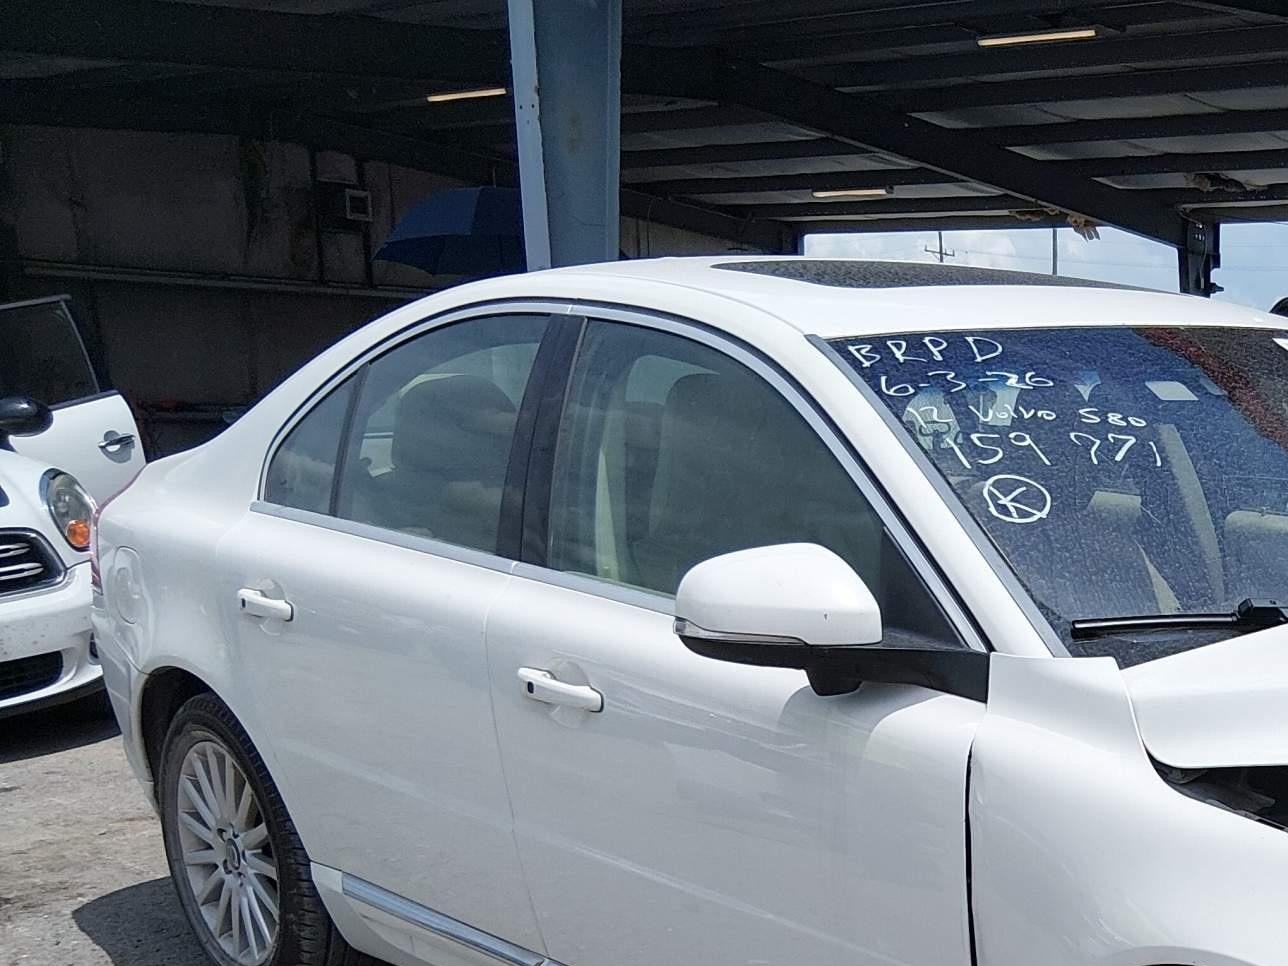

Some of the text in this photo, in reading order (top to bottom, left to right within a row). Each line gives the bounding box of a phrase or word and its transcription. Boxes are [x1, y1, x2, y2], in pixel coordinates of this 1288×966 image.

[847, 336, 1003, 368] BRPD
[880, 370, 1055, 396] 6-3-26
[1078, 407, 1148, 428] S80
[945, 432, 1162, 469] 159 771
